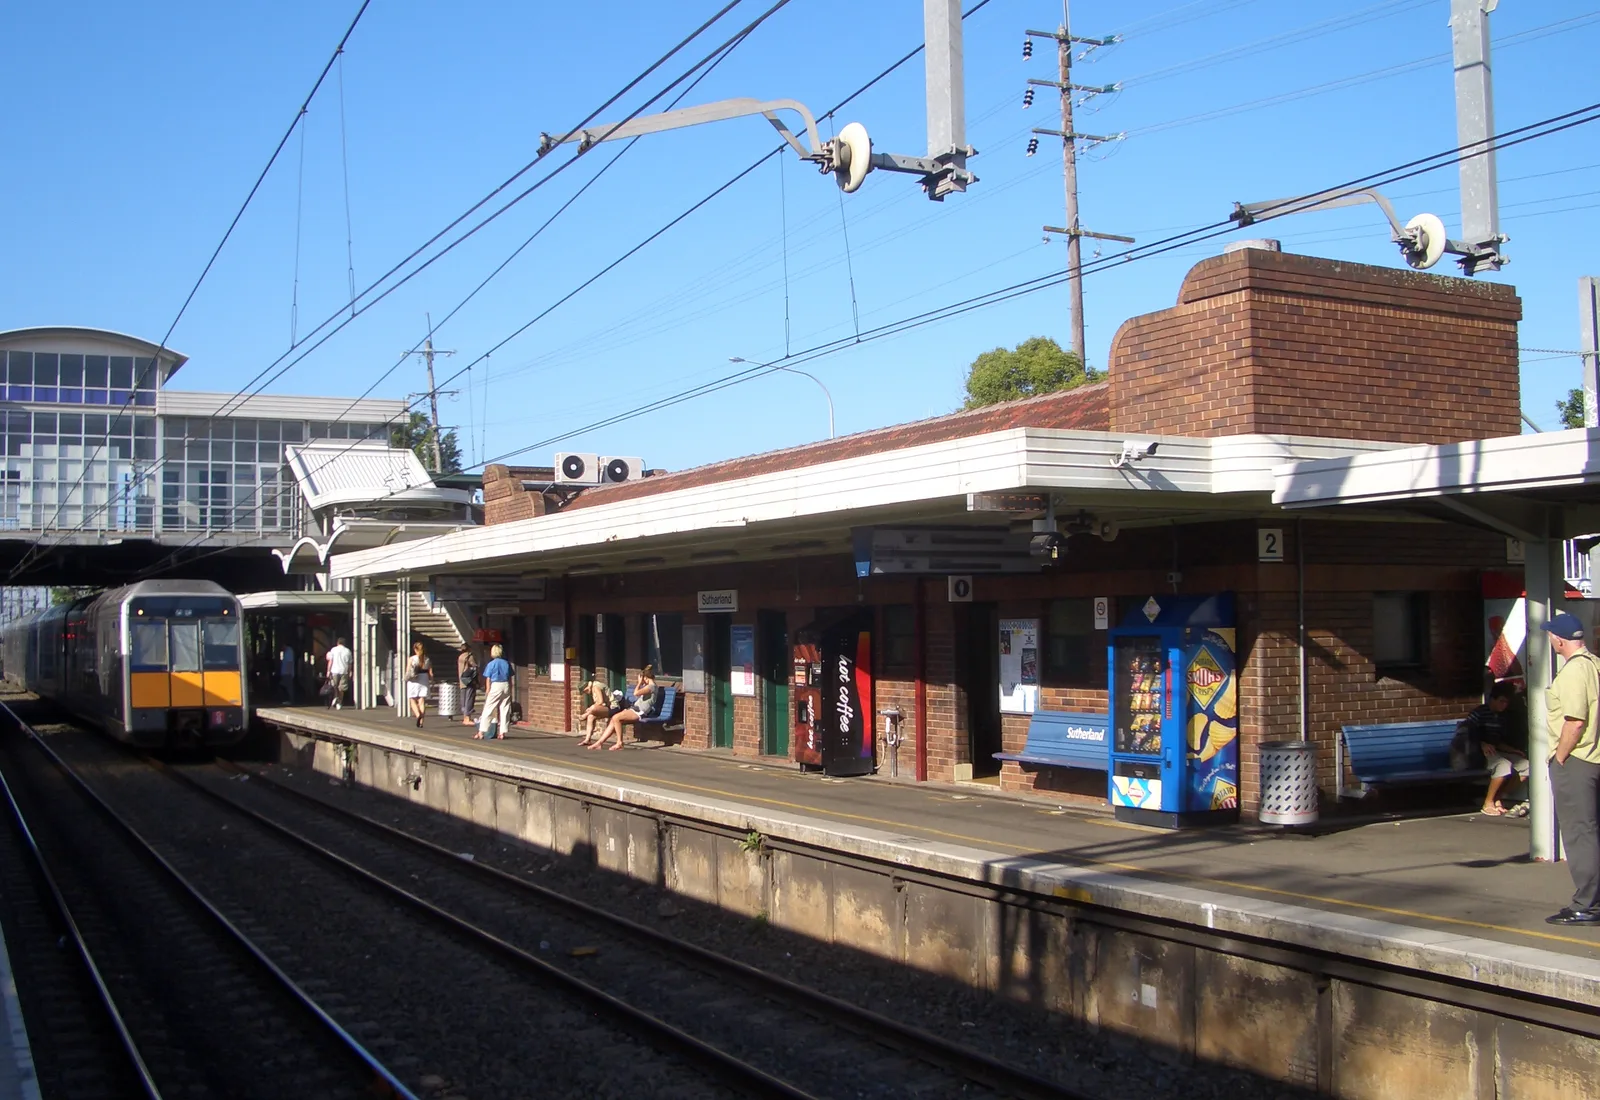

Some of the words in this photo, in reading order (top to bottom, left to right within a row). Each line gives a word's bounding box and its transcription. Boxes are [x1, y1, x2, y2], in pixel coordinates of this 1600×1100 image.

[1265, 533, 1277, 554] 2
[701, 593, 732, 606] Sutherland
[838, 654, 853, 683] hot
[806, 695, 815, 727] coffee
[836, 686, 854, 733] coffee
[806, 729, 815, 750] hot
[1066, 726, 1105, 741] Sutherland
[1213, 786, 1235, 807] POTATO
